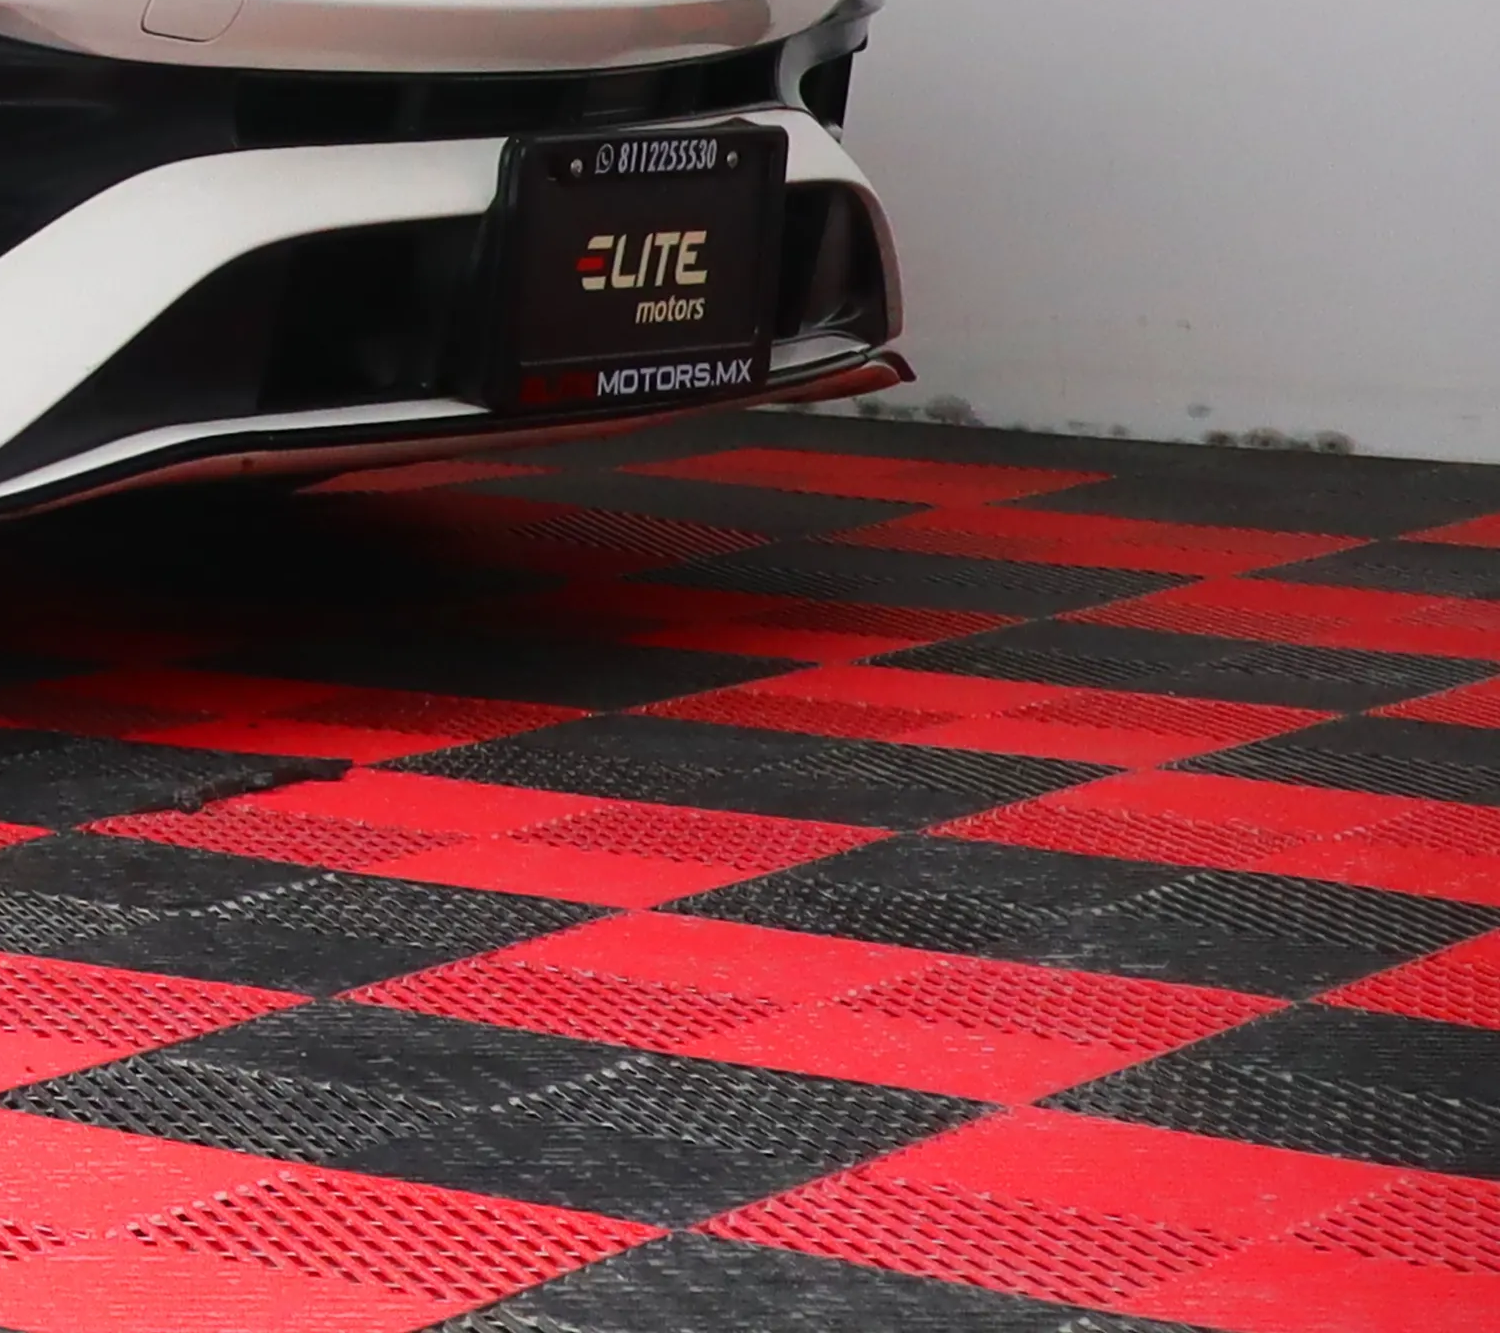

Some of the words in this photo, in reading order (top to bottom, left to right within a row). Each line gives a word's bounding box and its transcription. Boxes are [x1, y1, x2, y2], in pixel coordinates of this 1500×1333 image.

[618, 138, 718, 174] 8112255530
[576, 230, 708, 291] ELITE
[635, 295, 705, 324] motors
